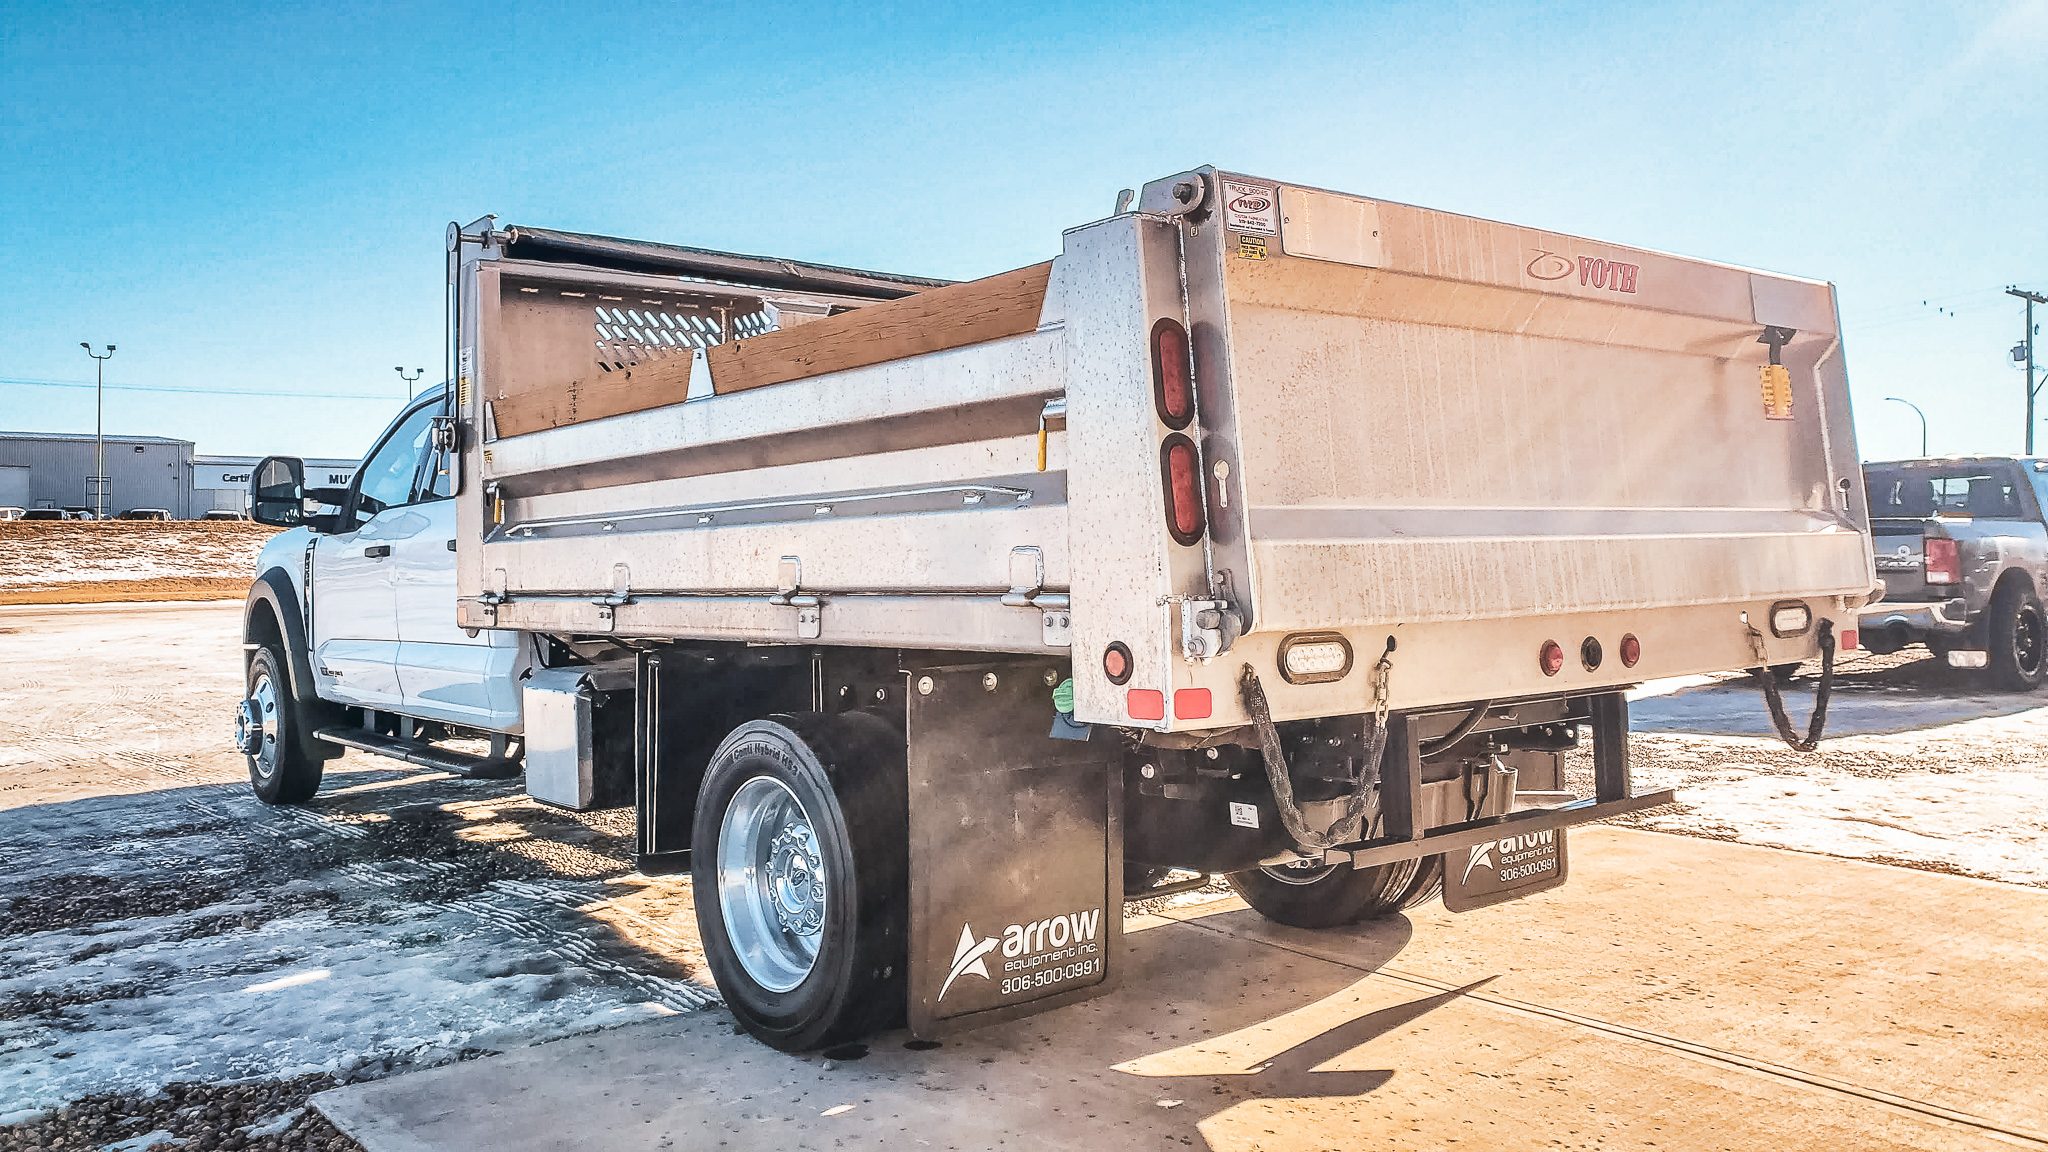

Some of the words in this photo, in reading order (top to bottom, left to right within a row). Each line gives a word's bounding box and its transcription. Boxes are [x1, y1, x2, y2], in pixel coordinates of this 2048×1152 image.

[1229, 185, 1246, 193] TRUCK
[1241, 236, 1264, 245] CAUTION
[1578, 256, 1640, 293] VOTH
[754, 743, 781, 761] Hybrid
[1501, 848, 1542, 865] equipment
[1500, 857, 1556, 881] 306-500-0991
[1002, 908, 1100, 958] arrow
[1004, 947, 1075, 972] equipment
[1077, 943, 1098, 956] inc.
[1001, 958, 1100, 995] 306-500-0991
